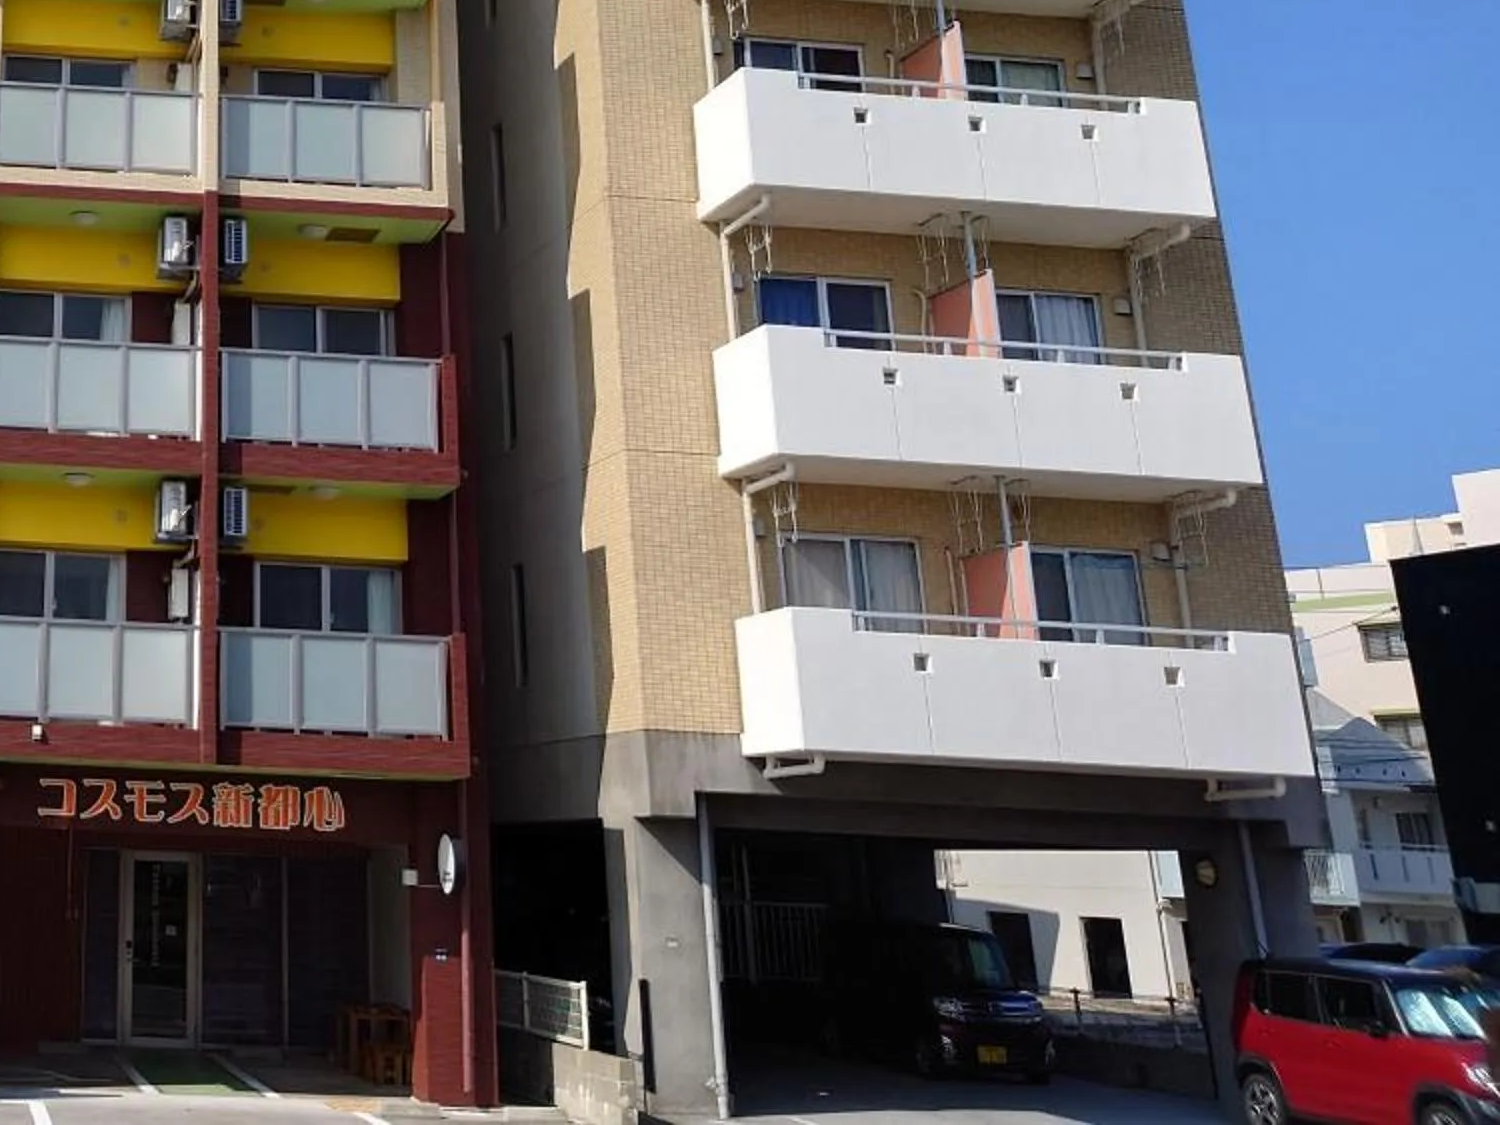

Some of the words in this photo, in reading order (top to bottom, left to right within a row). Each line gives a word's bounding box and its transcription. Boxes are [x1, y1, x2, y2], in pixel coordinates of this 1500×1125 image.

[37, 777, 346, 832] コスモス新都心
